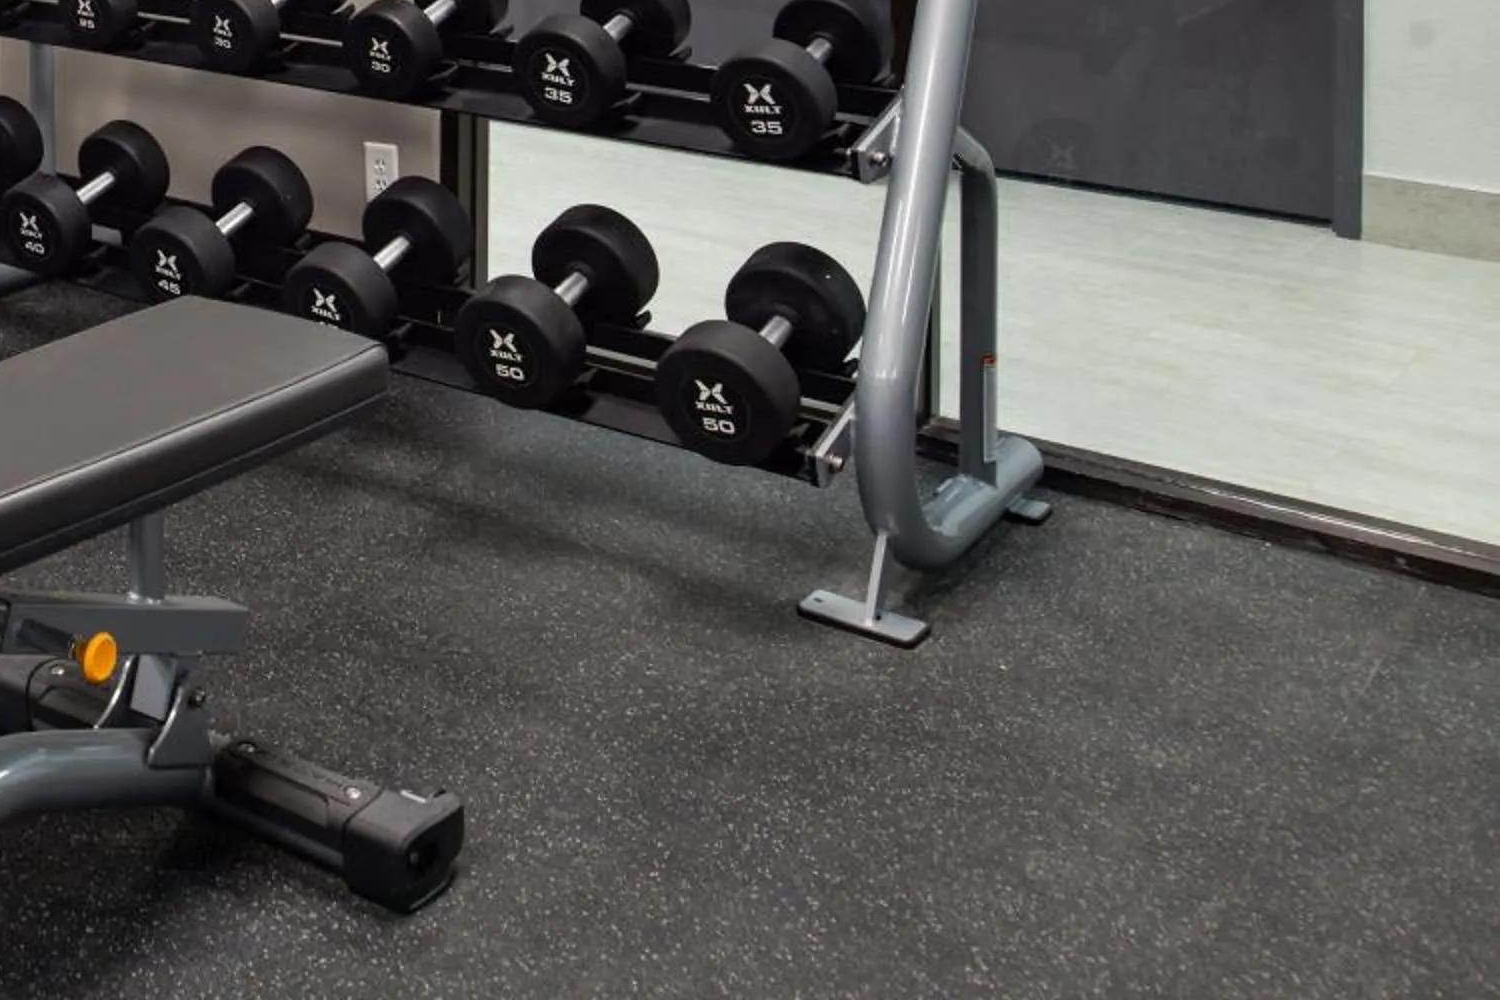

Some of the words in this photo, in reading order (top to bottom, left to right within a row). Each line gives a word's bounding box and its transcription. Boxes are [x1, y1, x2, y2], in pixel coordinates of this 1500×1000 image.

[541, 72, 575, 87] XULT
[544, 87, 573, 105] 35
[744, 104, 783, 116] XULT
[751, 120, 784, 135] 35
[25, 241, 45, 255] 40
[489, 349, 523, 363] XULT
[495, 363, 525, 381] 50
[695, 400, 733, 415] XULT
[702, 416, 735, 434] 50
